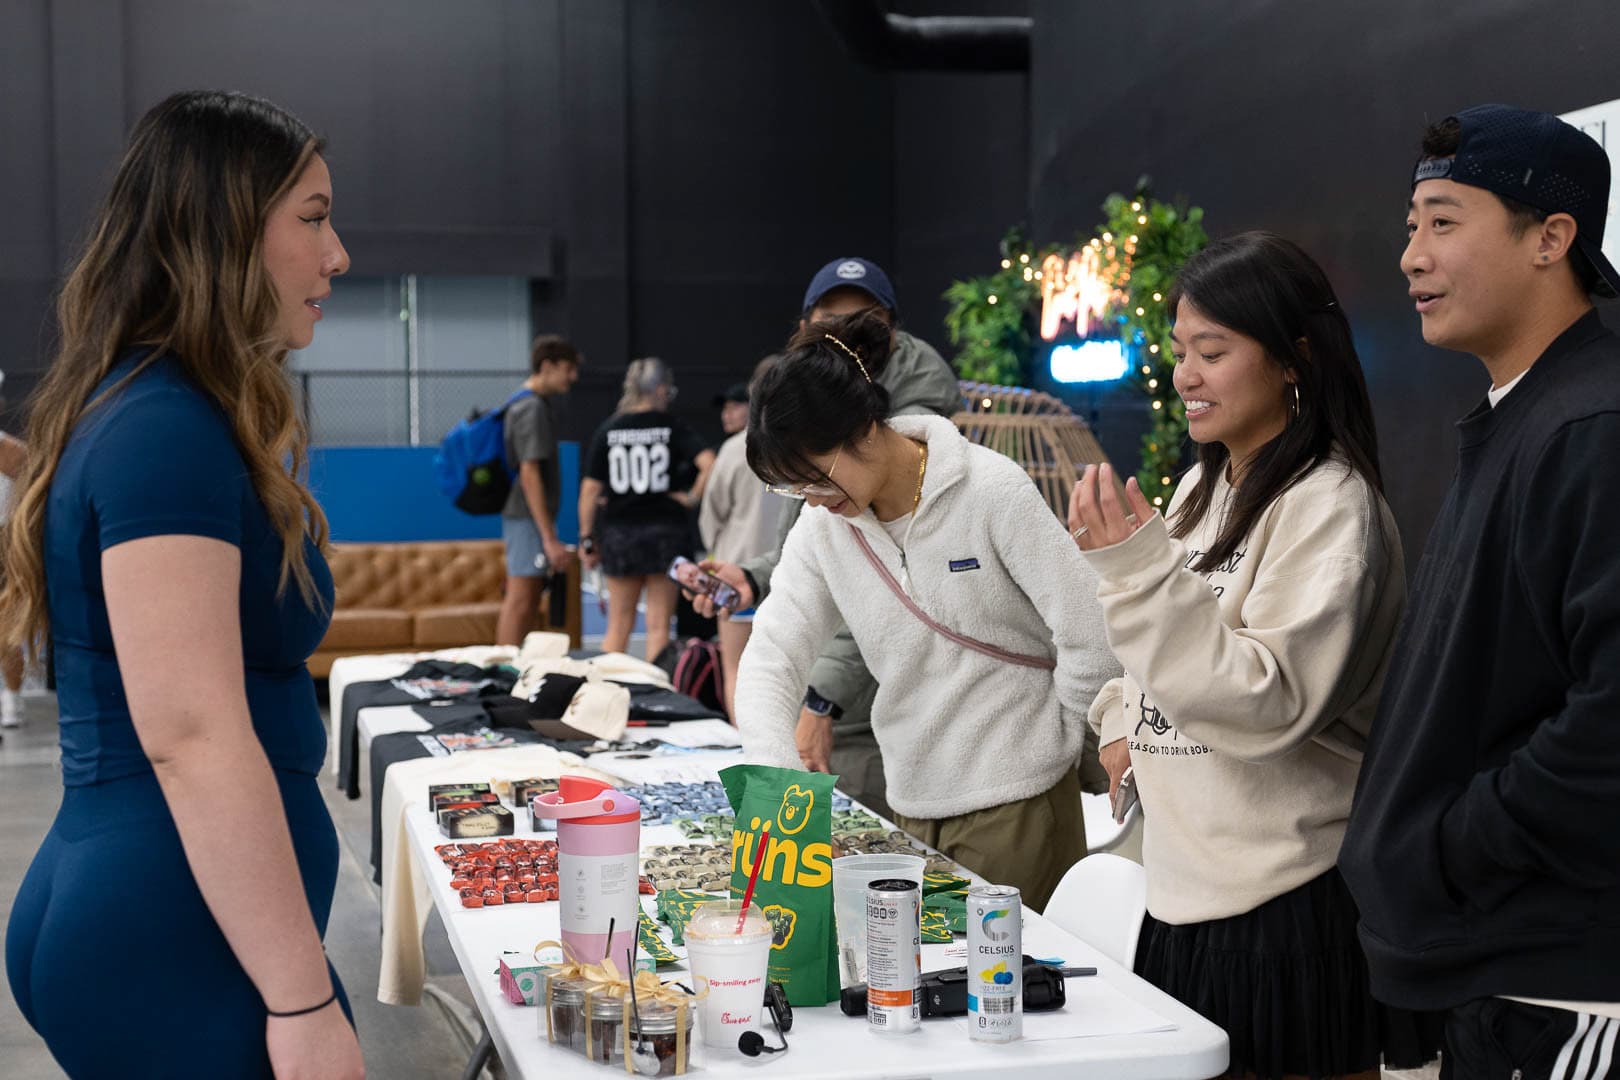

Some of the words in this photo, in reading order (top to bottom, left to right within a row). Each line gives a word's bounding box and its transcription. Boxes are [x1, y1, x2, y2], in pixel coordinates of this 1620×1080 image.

[608, 443, 670, 494] 002
[1161, 746, 1169, 755] TO
[1190, 745, 1214, 755] BOB
[978, 944, 1015, 955] CELSIUS
